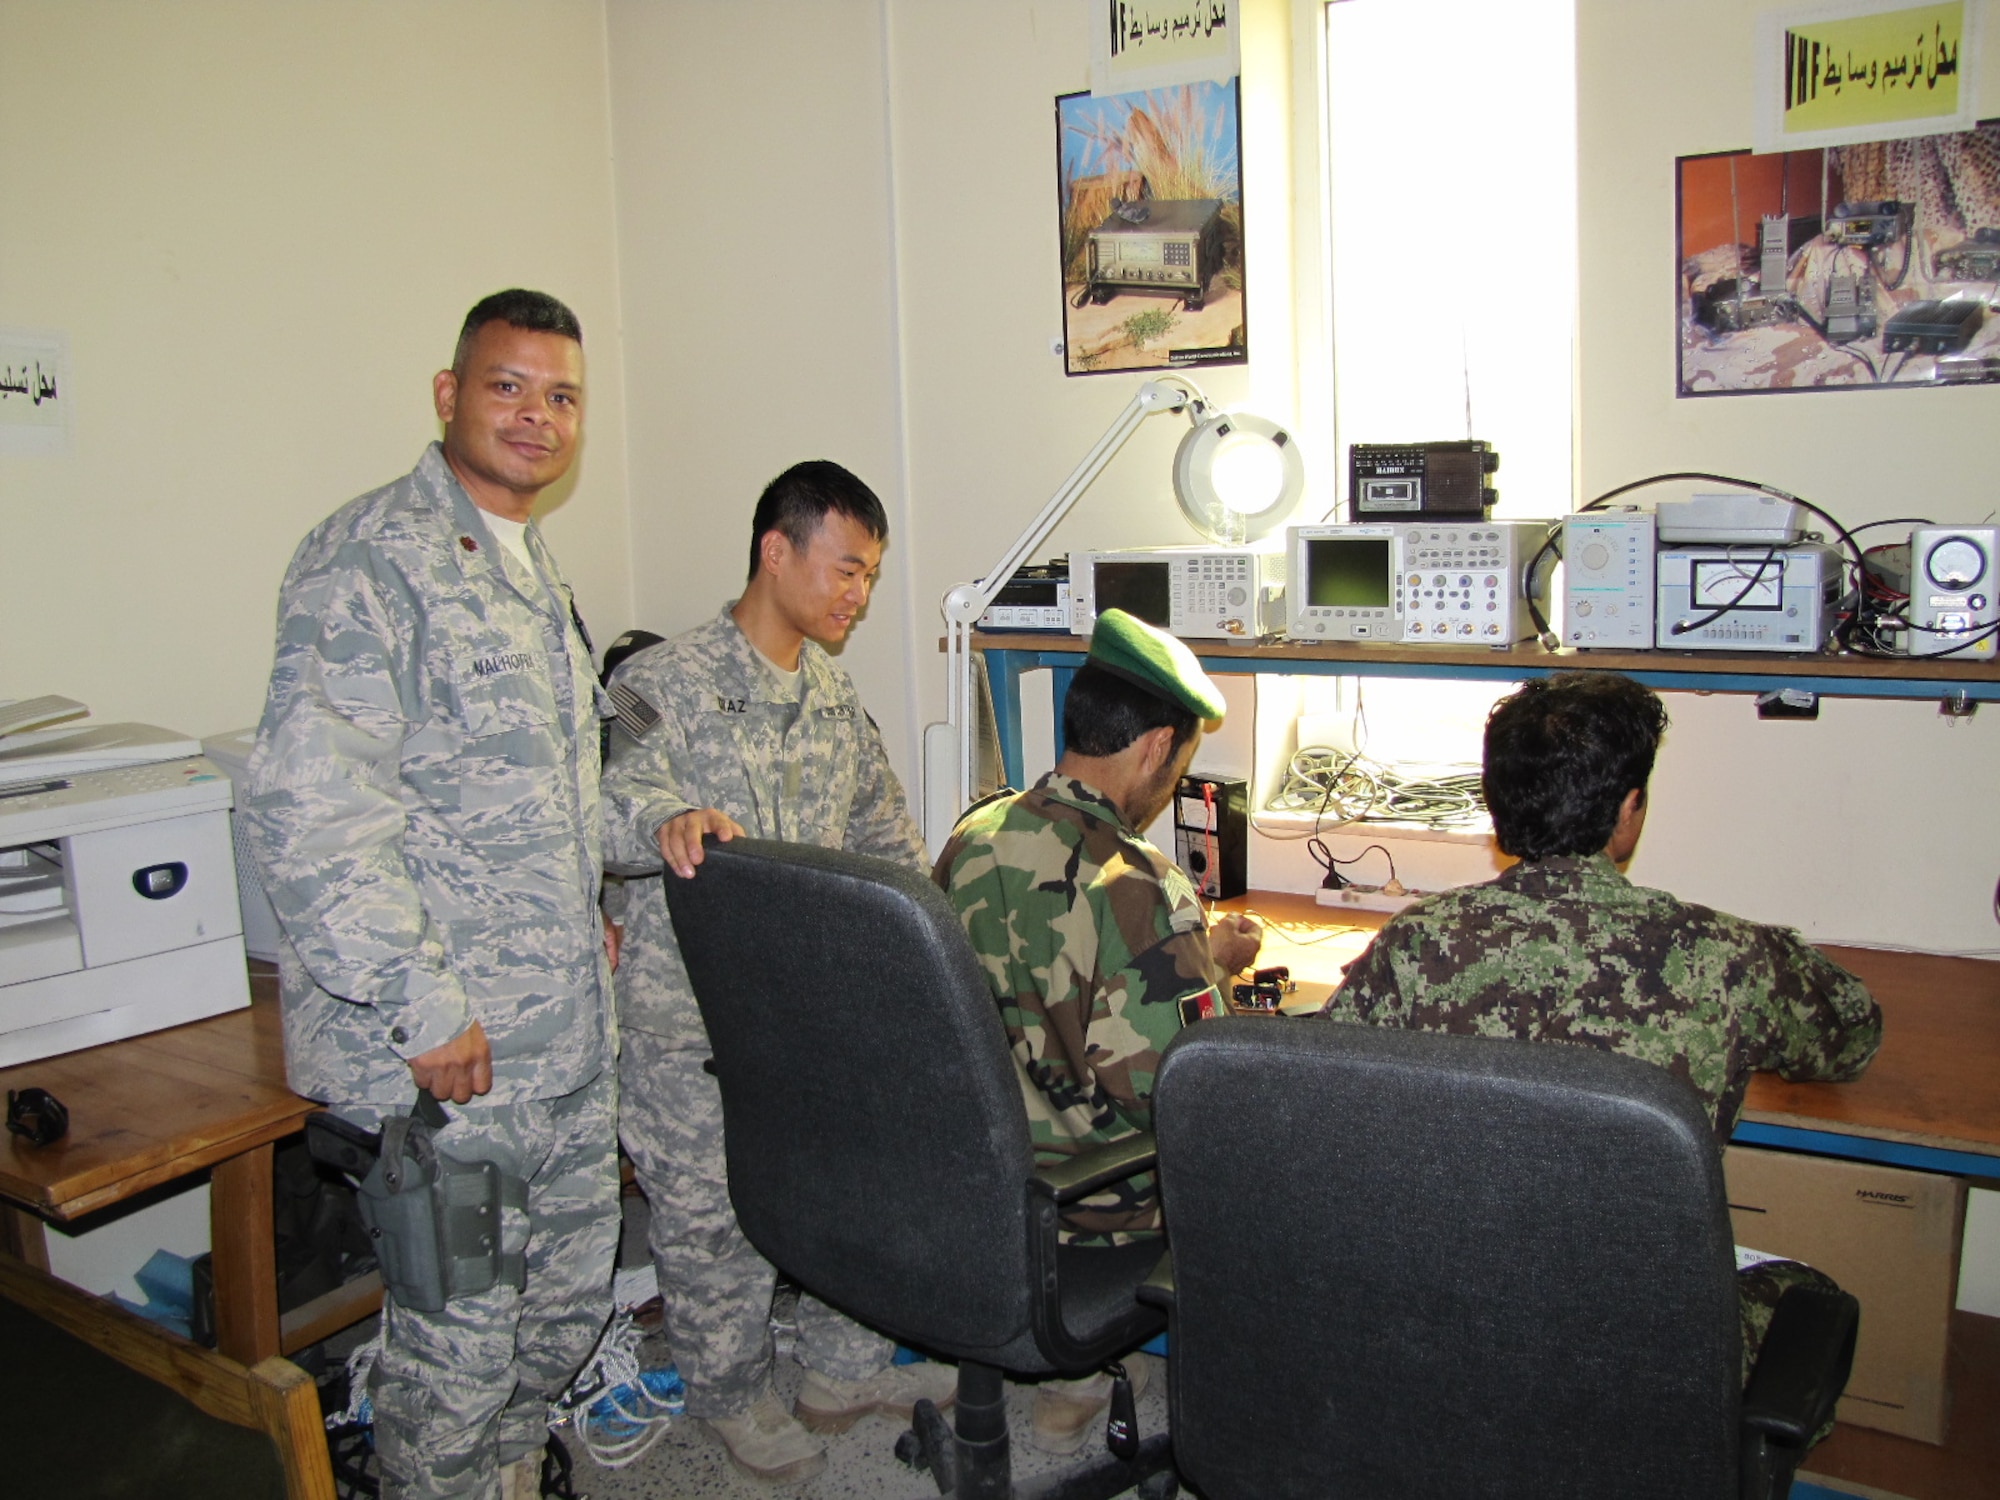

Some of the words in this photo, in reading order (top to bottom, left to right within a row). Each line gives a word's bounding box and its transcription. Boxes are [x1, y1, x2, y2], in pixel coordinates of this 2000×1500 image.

[1785, 30, 1820, 112] VHF
[1927, 20, 1957, 90] محل
[33, 361, 57, 406] محل
[1856, 1189, 1911, 1203] HARRIS
